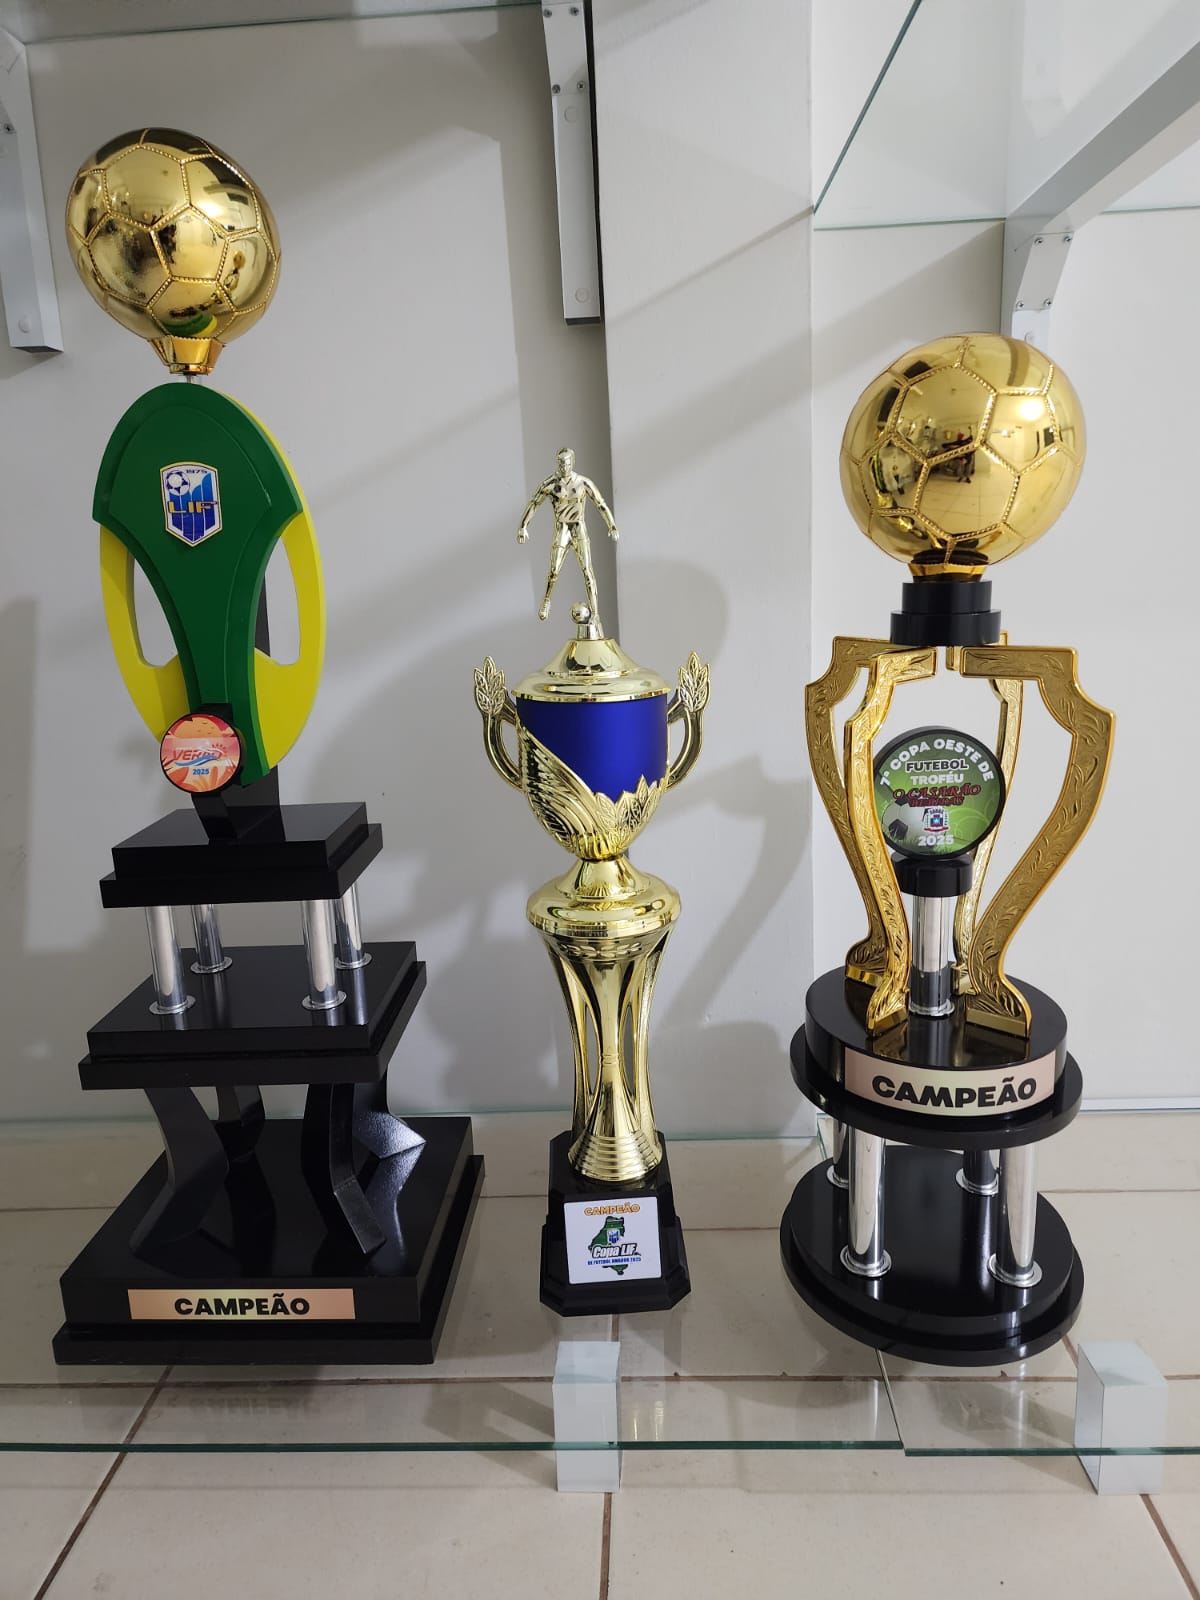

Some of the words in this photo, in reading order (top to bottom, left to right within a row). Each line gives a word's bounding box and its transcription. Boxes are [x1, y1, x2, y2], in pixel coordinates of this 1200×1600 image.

[168, 501, 219, 513] LIF
[890, 741, 931, 770] COPA
[933, 738, 982, 763] OESTE
[978, 761, 994, 781] DE
[905, 758, 969, 772] FUTEBOL
[910, 771, 964, 786] TROFÉU
[893, 788, 905, 800] O
[918, 835, 954, 846] 2025
[872, 1075, 1037, 1108] CAMPEÃO
[584, 1202, 640, 1216] CAMPEÃO
[592, 1246, 620, 1259] Copa
[620, 1243, 637, 1256] LIF
[174, 1293, 310, 1316] CAMPEÃO
